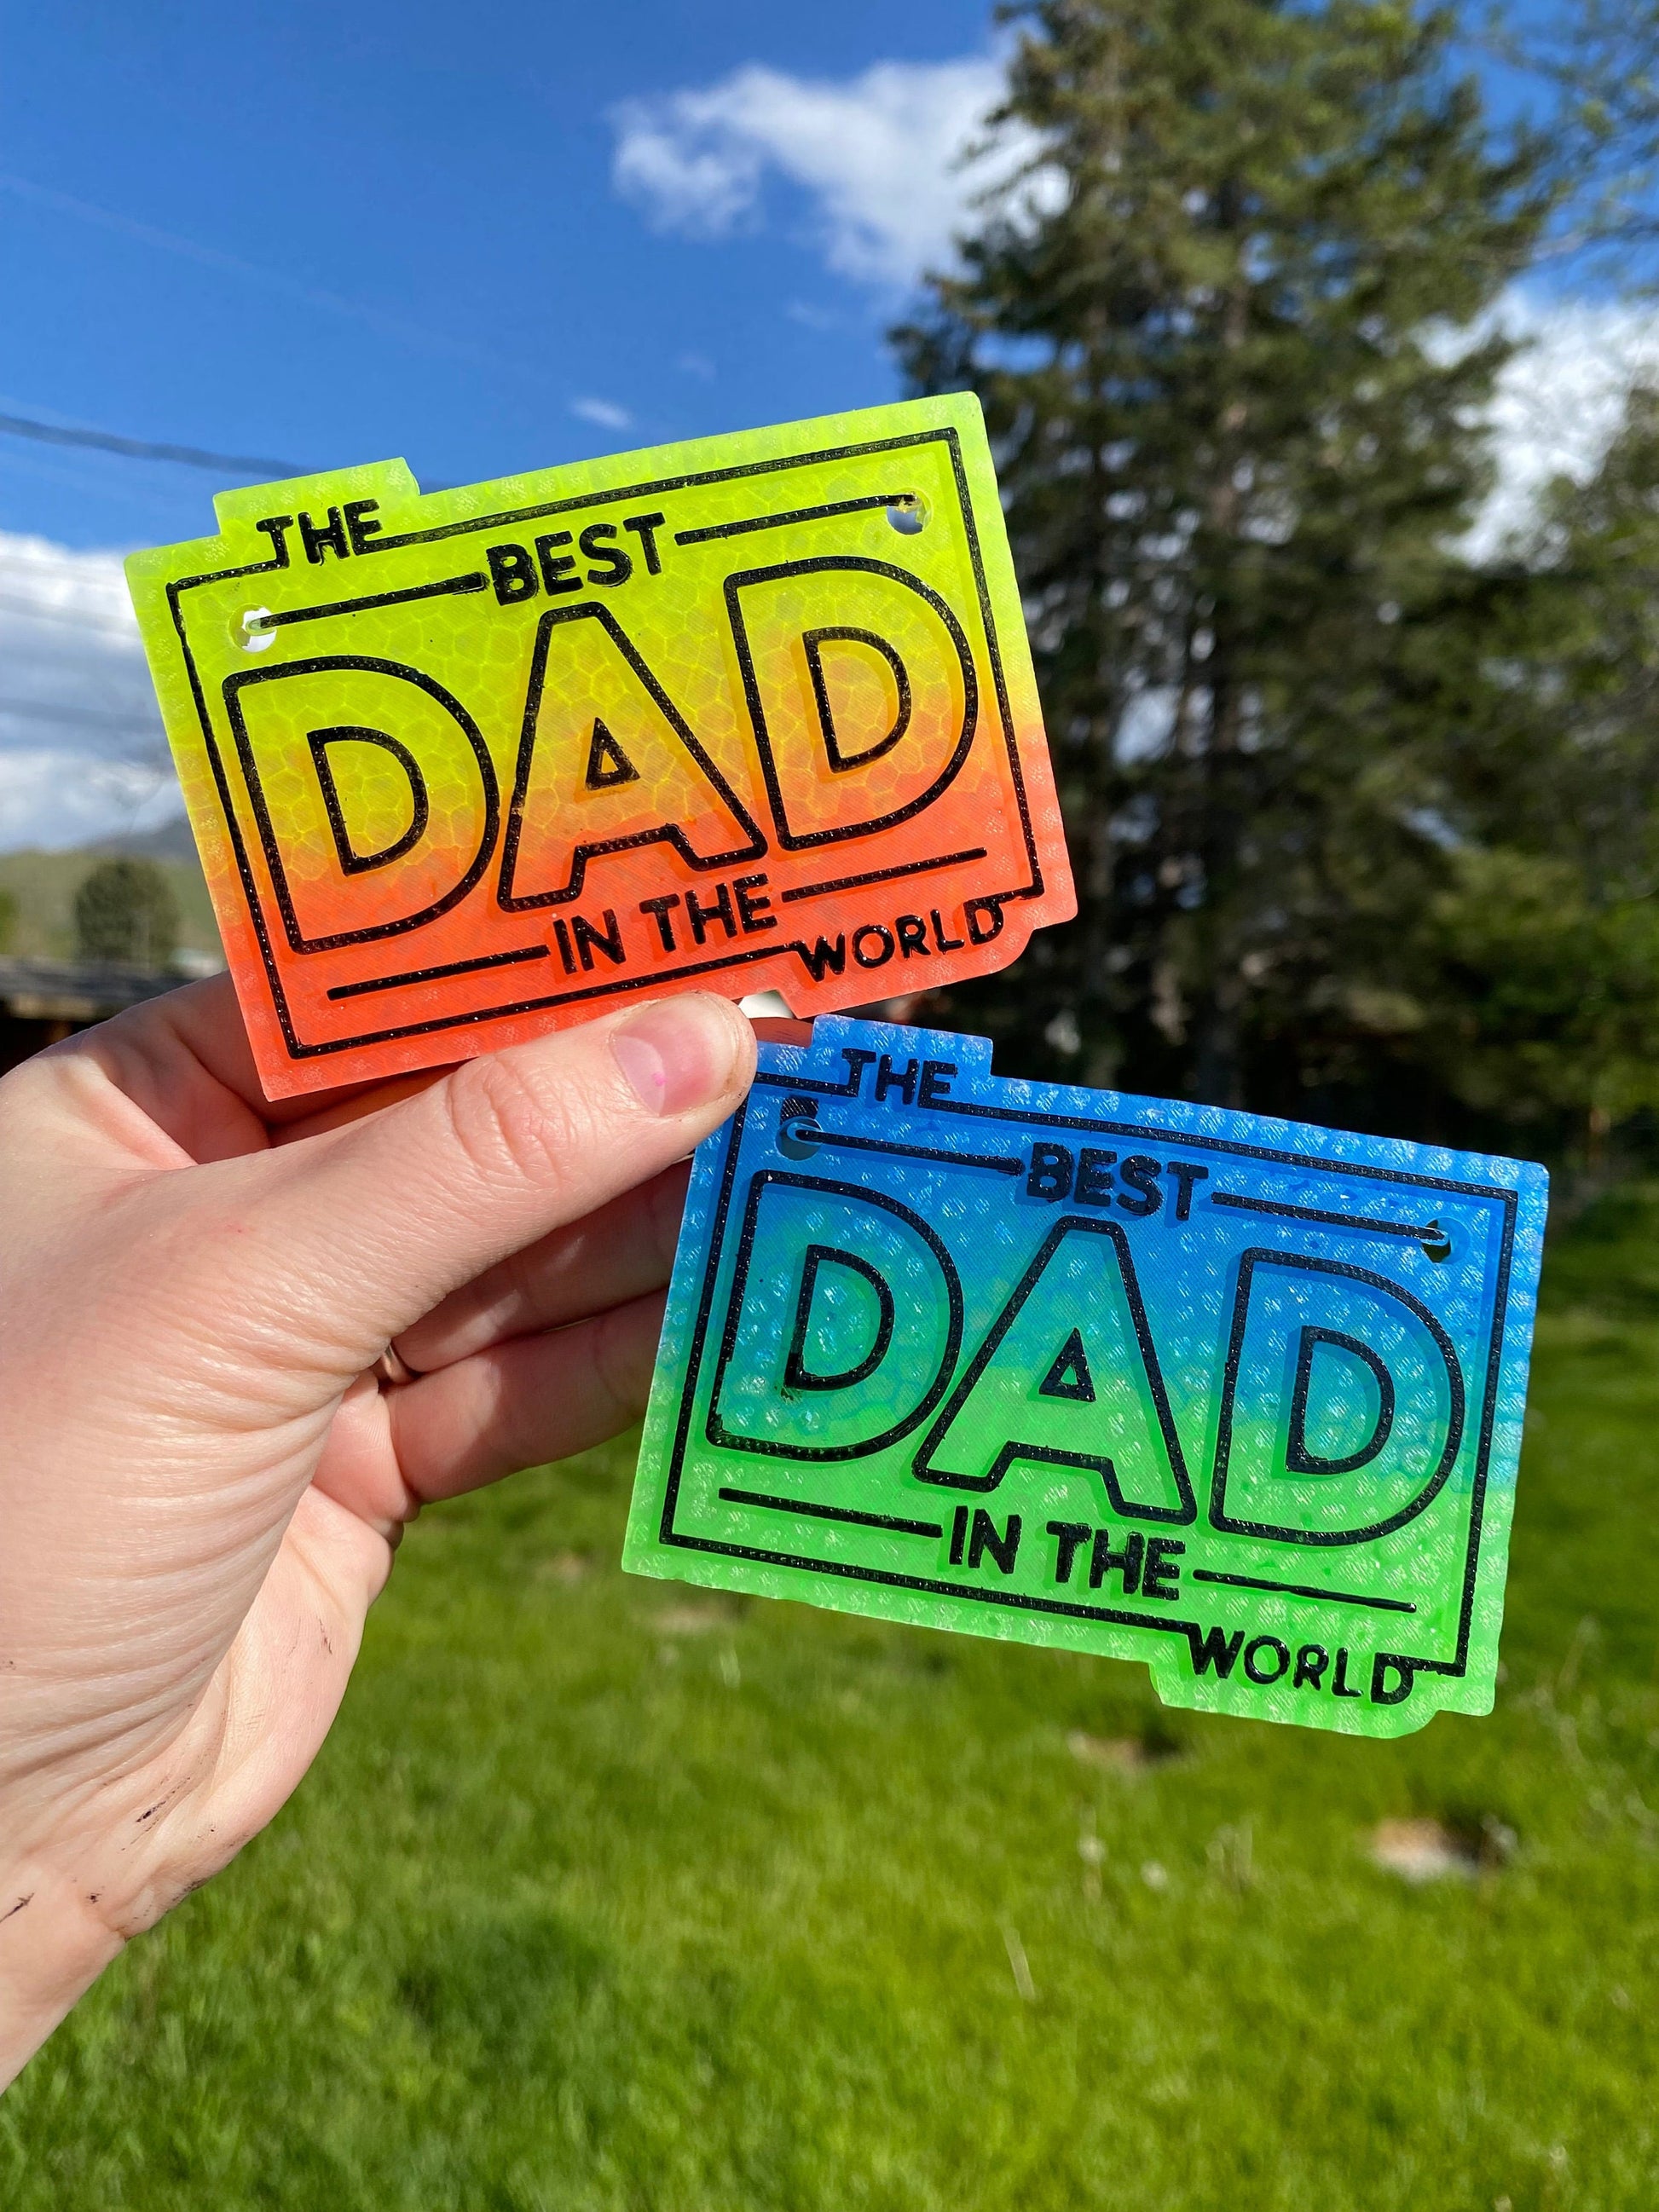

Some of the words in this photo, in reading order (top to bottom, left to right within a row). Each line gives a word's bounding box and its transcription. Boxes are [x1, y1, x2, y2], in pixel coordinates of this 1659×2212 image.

[257, 500, 385, 568] THE
[488, 513, 666, 604] BEST
[223, 557, 978, 954] DAD
[553, 910, 626, 975] IN
[641, 875, 777, 951] THE
[799, 898, 1004, 982] WORLD
[842, 1049, 957, 1109] THE
[1026, 1144, 1209, 1221] BEST
[707, 1171, 1465, 1545] DAD
[950, 1506, 1020, 1574] IN
[1049, 1522, 1186, 1600] THE
[1191, 1625, 1417, 1704] WORLD
